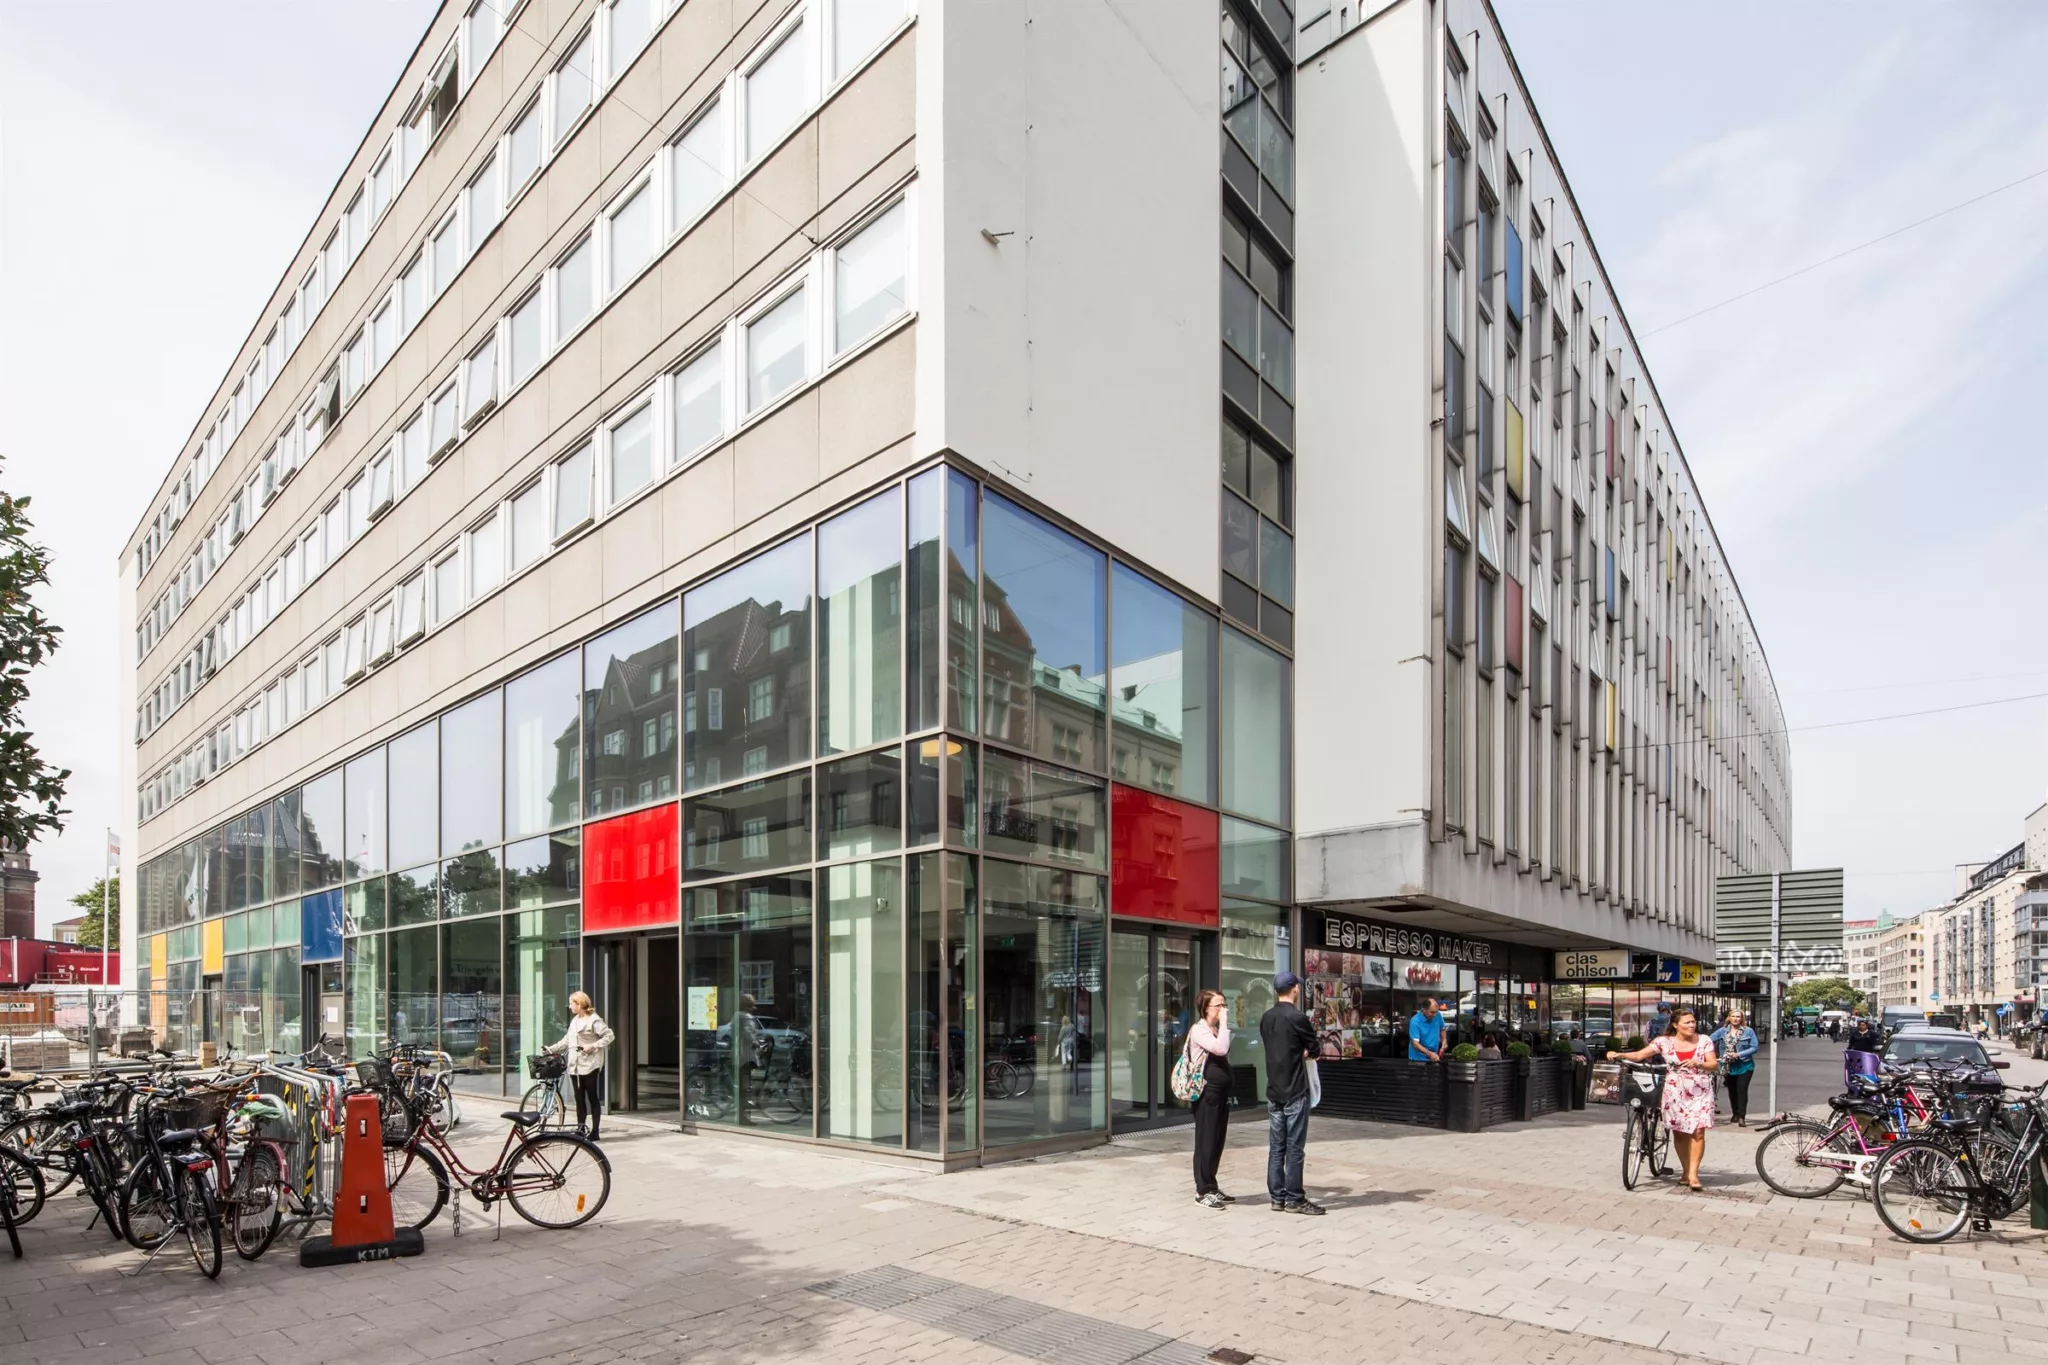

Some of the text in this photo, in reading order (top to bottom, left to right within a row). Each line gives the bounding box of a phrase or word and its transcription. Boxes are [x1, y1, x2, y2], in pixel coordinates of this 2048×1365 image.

[1325, 918, 1492, 965] ESPRESSO MAKER
[1566, 952, 1598, 965] clas
[1566, 965, 1618, 977] ohlson
[358, 1247, 389, 1261] KTM
